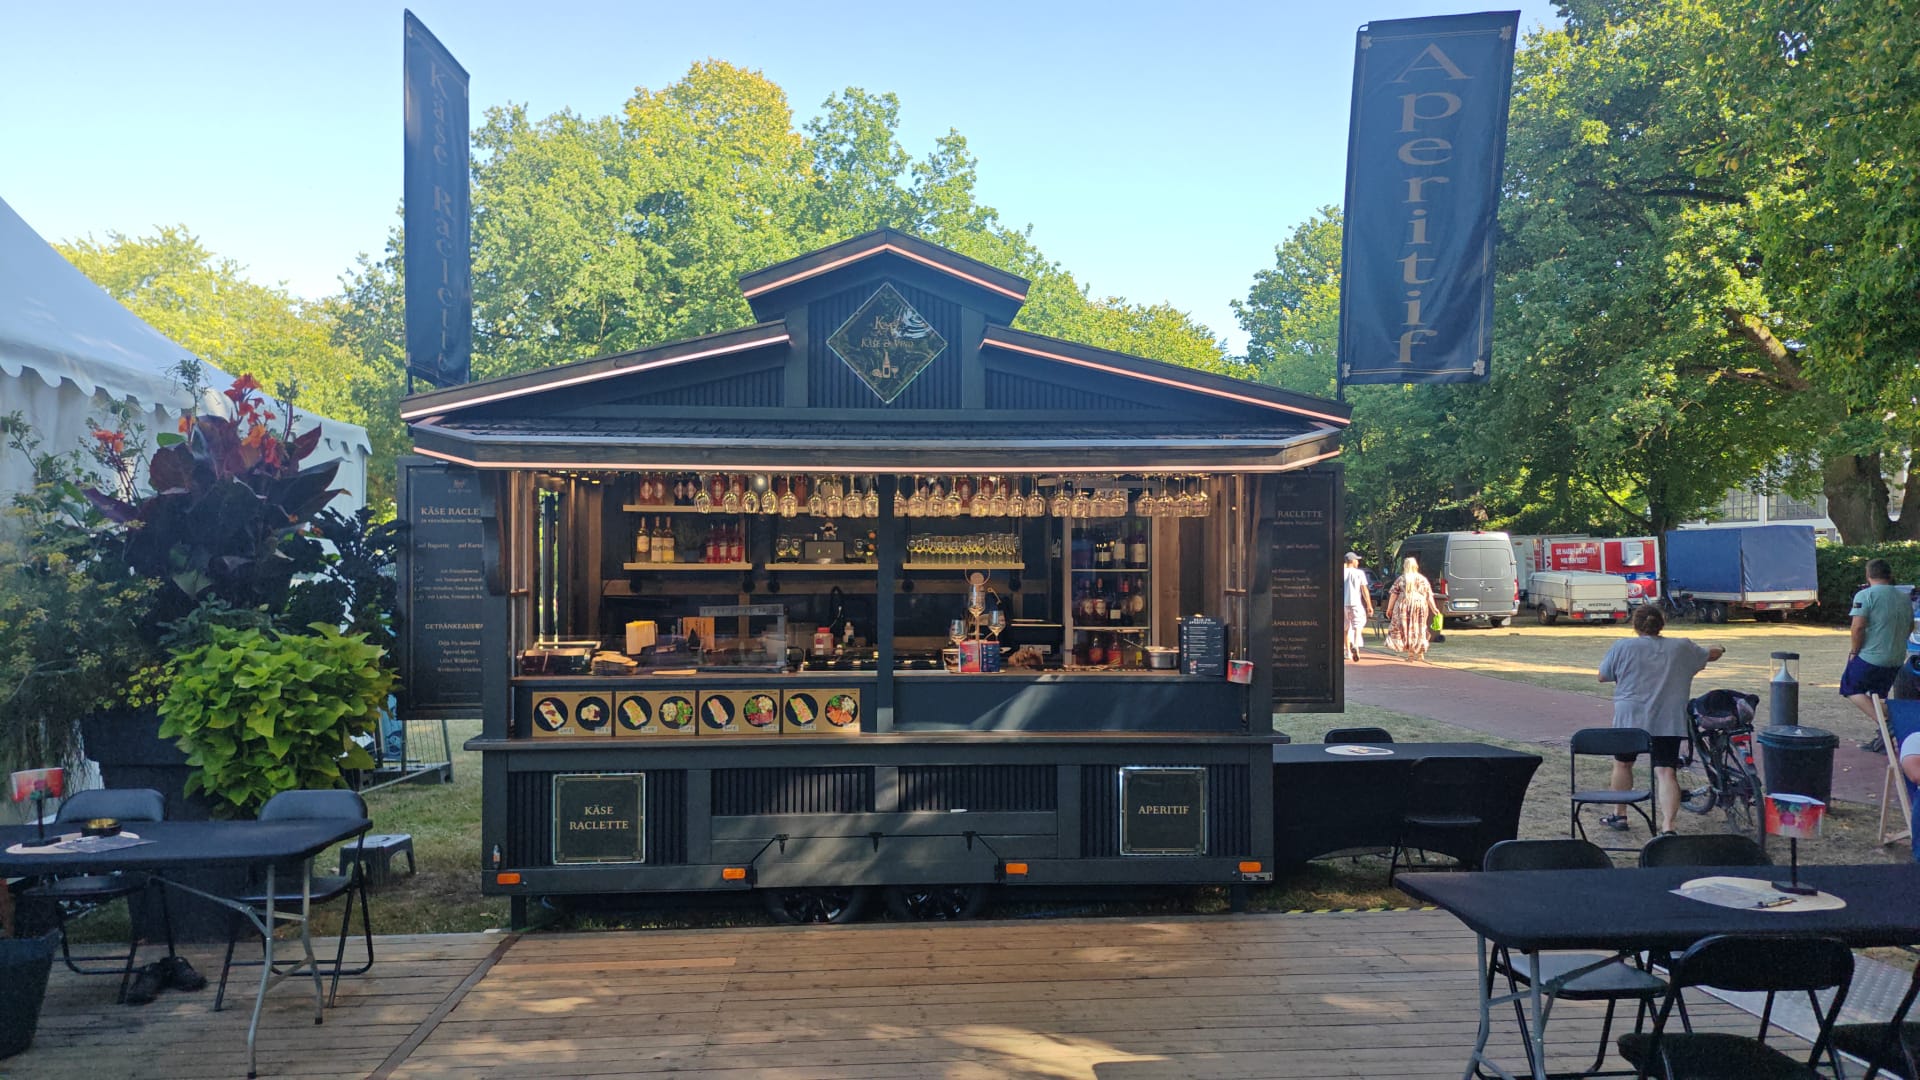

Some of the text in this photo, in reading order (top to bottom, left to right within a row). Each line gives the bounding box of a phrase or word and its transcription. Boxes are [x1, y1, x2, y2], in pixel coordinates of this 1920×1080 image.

[1389, 42, 1475, 364] Aperitif
[421, 505, 446, 515] KÄSE
[584, 804, 614, 815] KÄSE
[1138, 805, 1190, 815] APERITIF
[569, 821, 629, 830] RACLETTE
